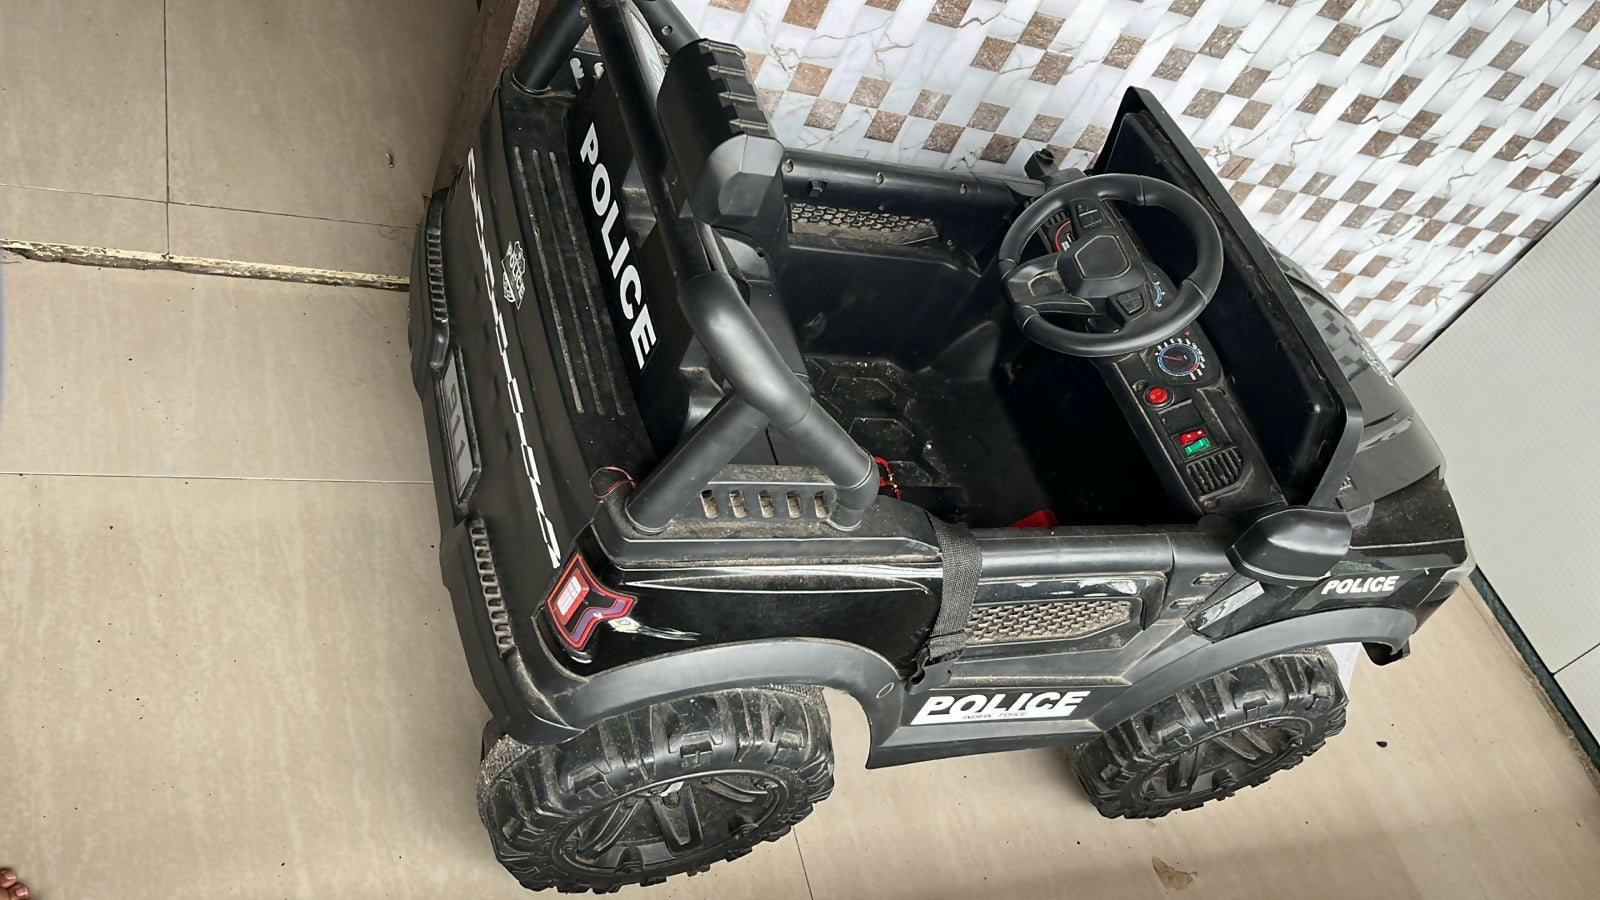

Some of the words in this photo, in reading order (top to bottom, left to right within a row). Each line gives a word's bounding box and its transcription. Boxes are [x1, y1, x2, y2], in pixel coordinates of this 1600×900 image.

[580, 122, 657, 370] POLICE
[1321, 575, 1400, 595] POLICE
[911, 690, 1091, 725] POLICE
